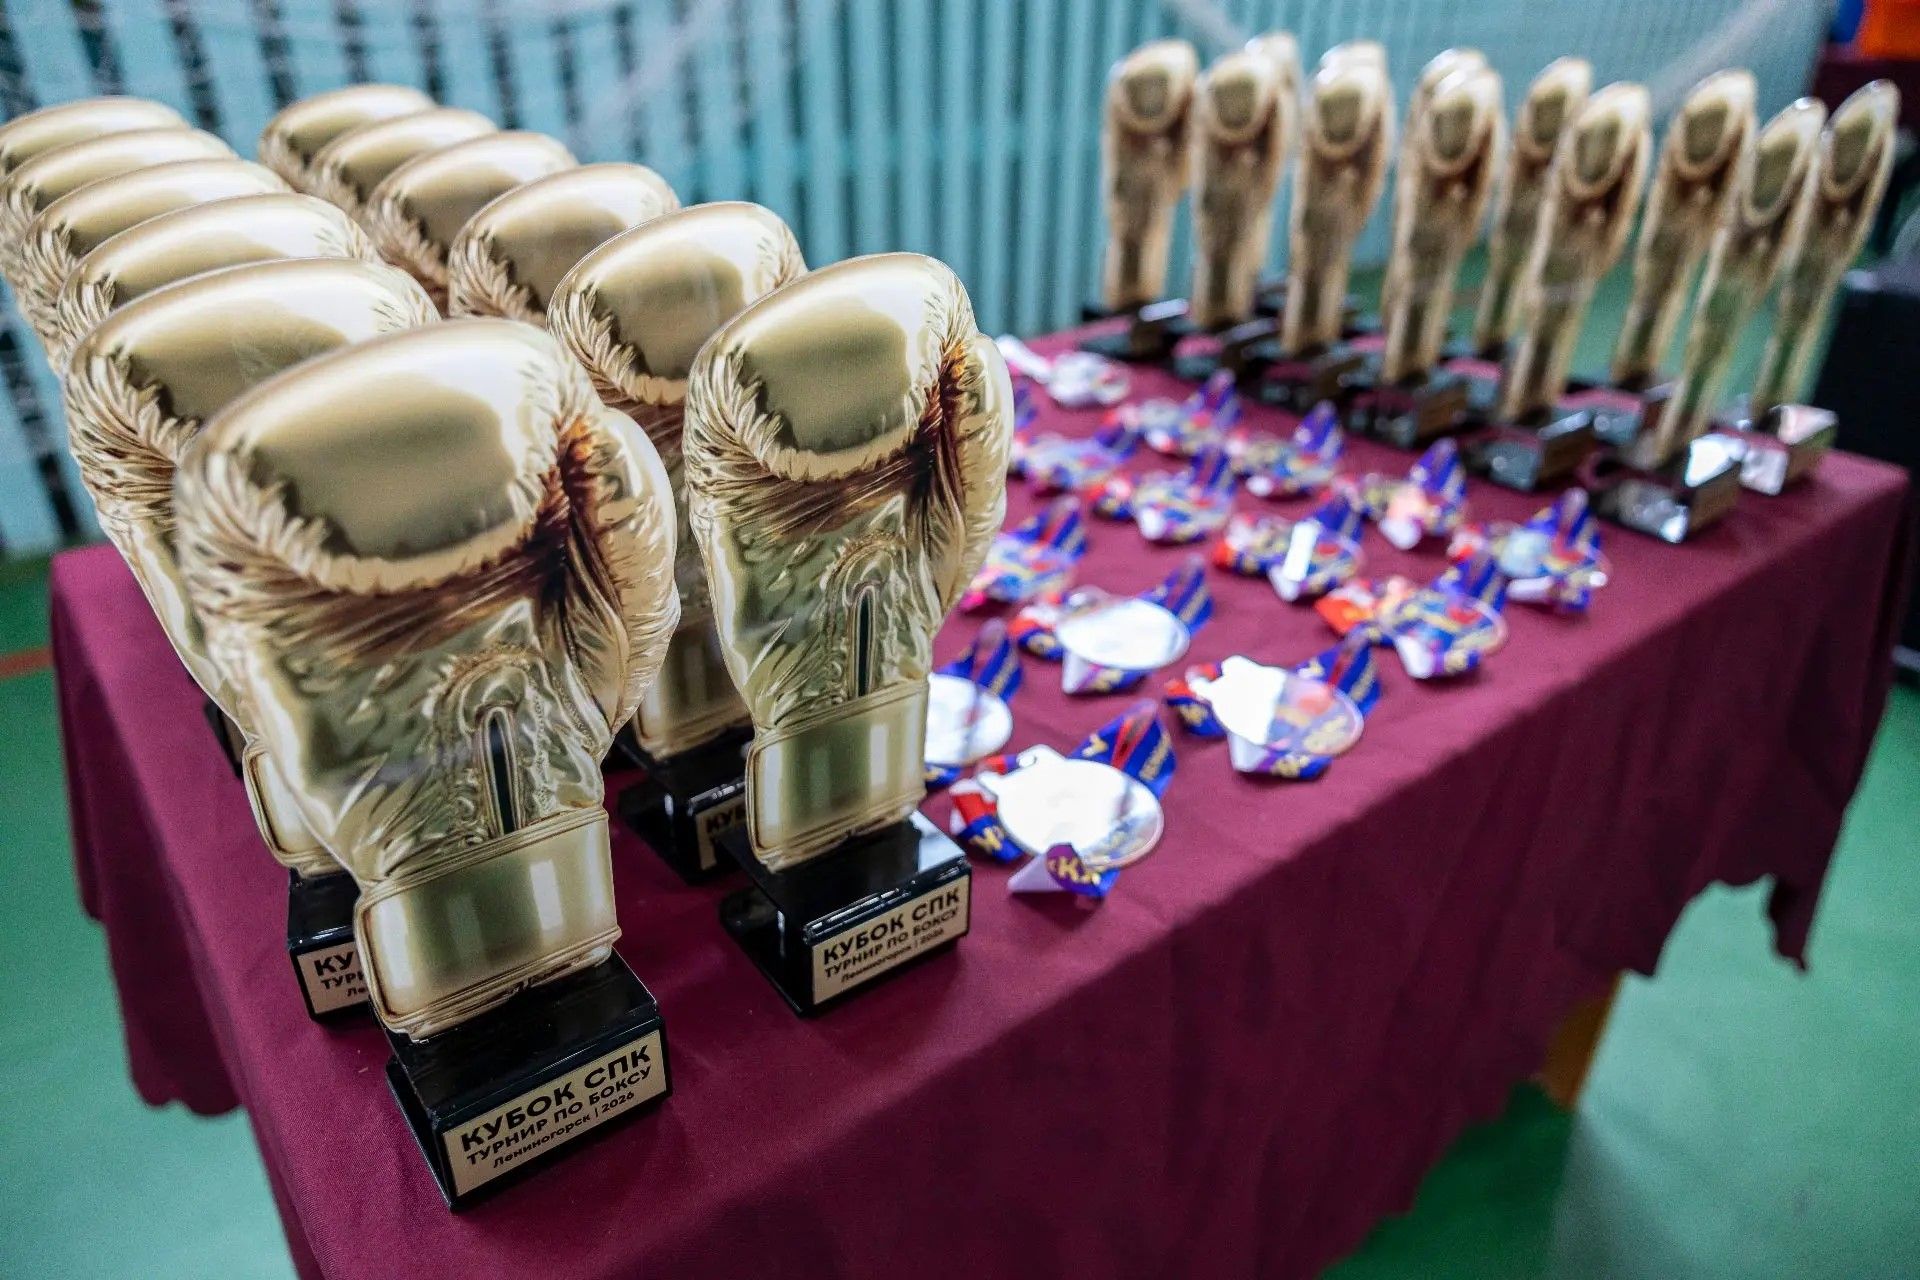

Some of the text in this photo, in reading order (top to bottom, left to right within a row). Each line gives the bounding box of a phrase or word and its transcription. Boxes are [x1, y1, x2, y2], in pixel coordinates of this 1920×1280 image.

[823, 888, 960, 966] КУБОК СПК
[824, 907, 959, 978] ТУРНИР ПО БОКСУ
[460, 1045, 651, 1152] КУБОК СПК
[466, 1066, 652, 1166] ТУРНИР ПО БОКСУ
[493, 1114, 591, 1168] Лениногорск
[601, 1091, 635, 1114] 2026
